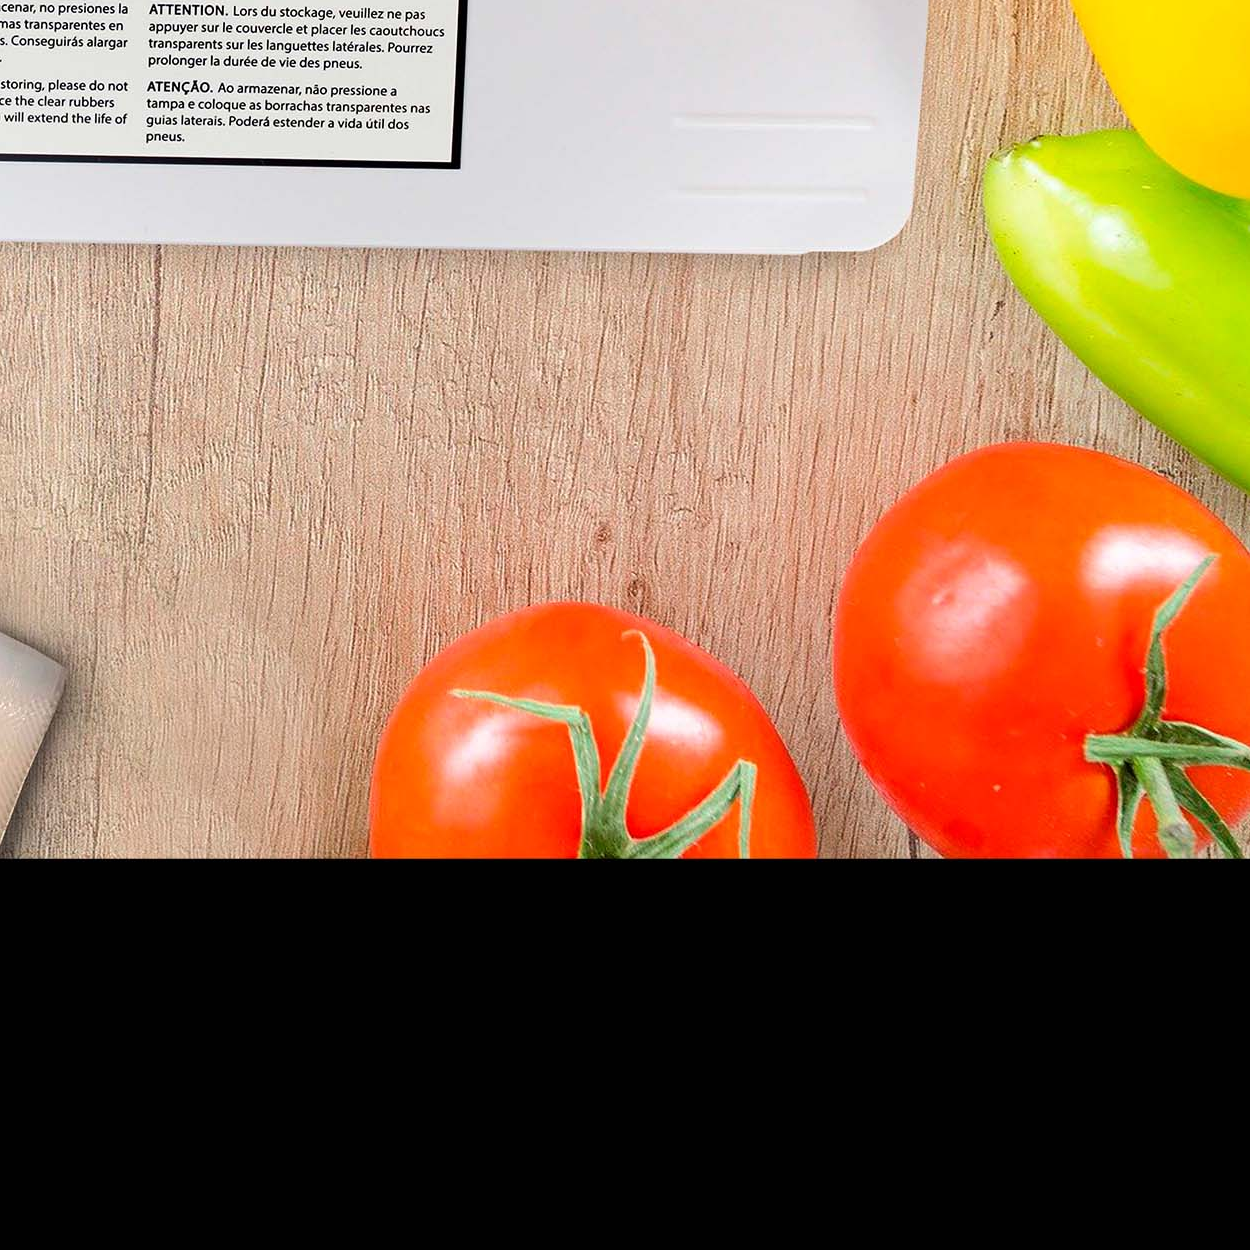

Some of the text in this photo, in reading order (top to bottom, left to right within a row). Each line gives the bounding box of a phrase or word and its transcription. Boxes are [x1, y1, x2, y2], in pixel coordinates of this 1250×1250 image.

[40, 5, 55, 13] no
[58, 3, 115, 16] presiones
[119, 3, 128, 14] la
[149, 4, 425, 22] ATTENTION. Lors du stockage, veuillez ne pas
[24, 20, 106, 33] transparentes
[109, 23, 123, 31] en
[149, 22, 445, 37] appuyer sur le couvercle et placer les caoutchoucs
[11, 35, 84, 49] Conseguirás
[87, 36, 128, 51] alargar
[149, 39, 433, 54] transparents sur les languettes latérales. Pourrez
[148, 54, 362, 71] prolonger la durée de vie des pneus.
[1, 79, 45, 93] storing,
[48, 79, 86, 93] please
[89, 80, 105, 91] do
[108, 82, 128, 92] not
[147, 80, 397, 98] ATENÇÃO. Ao armazenar, não pressione a
[15, 95, 35, 106] the
[38, 96, 66, 107] clear
[69, 96, 115, 108] rubbers
[147, 98, 431, 115] tampa e coloque as borrachas transparentes nas
[4, 112, 24, 122] will
[27, 113, 68, 123] extend
[72, 113, 91, 124] the
[95, 113, 112, 124] life
[115, 113, 128, 124] of
[146, 115, 409, 130] guias laterais. Poderá estender a vida útil dos
[146, 133, 185, 144] pneus.
